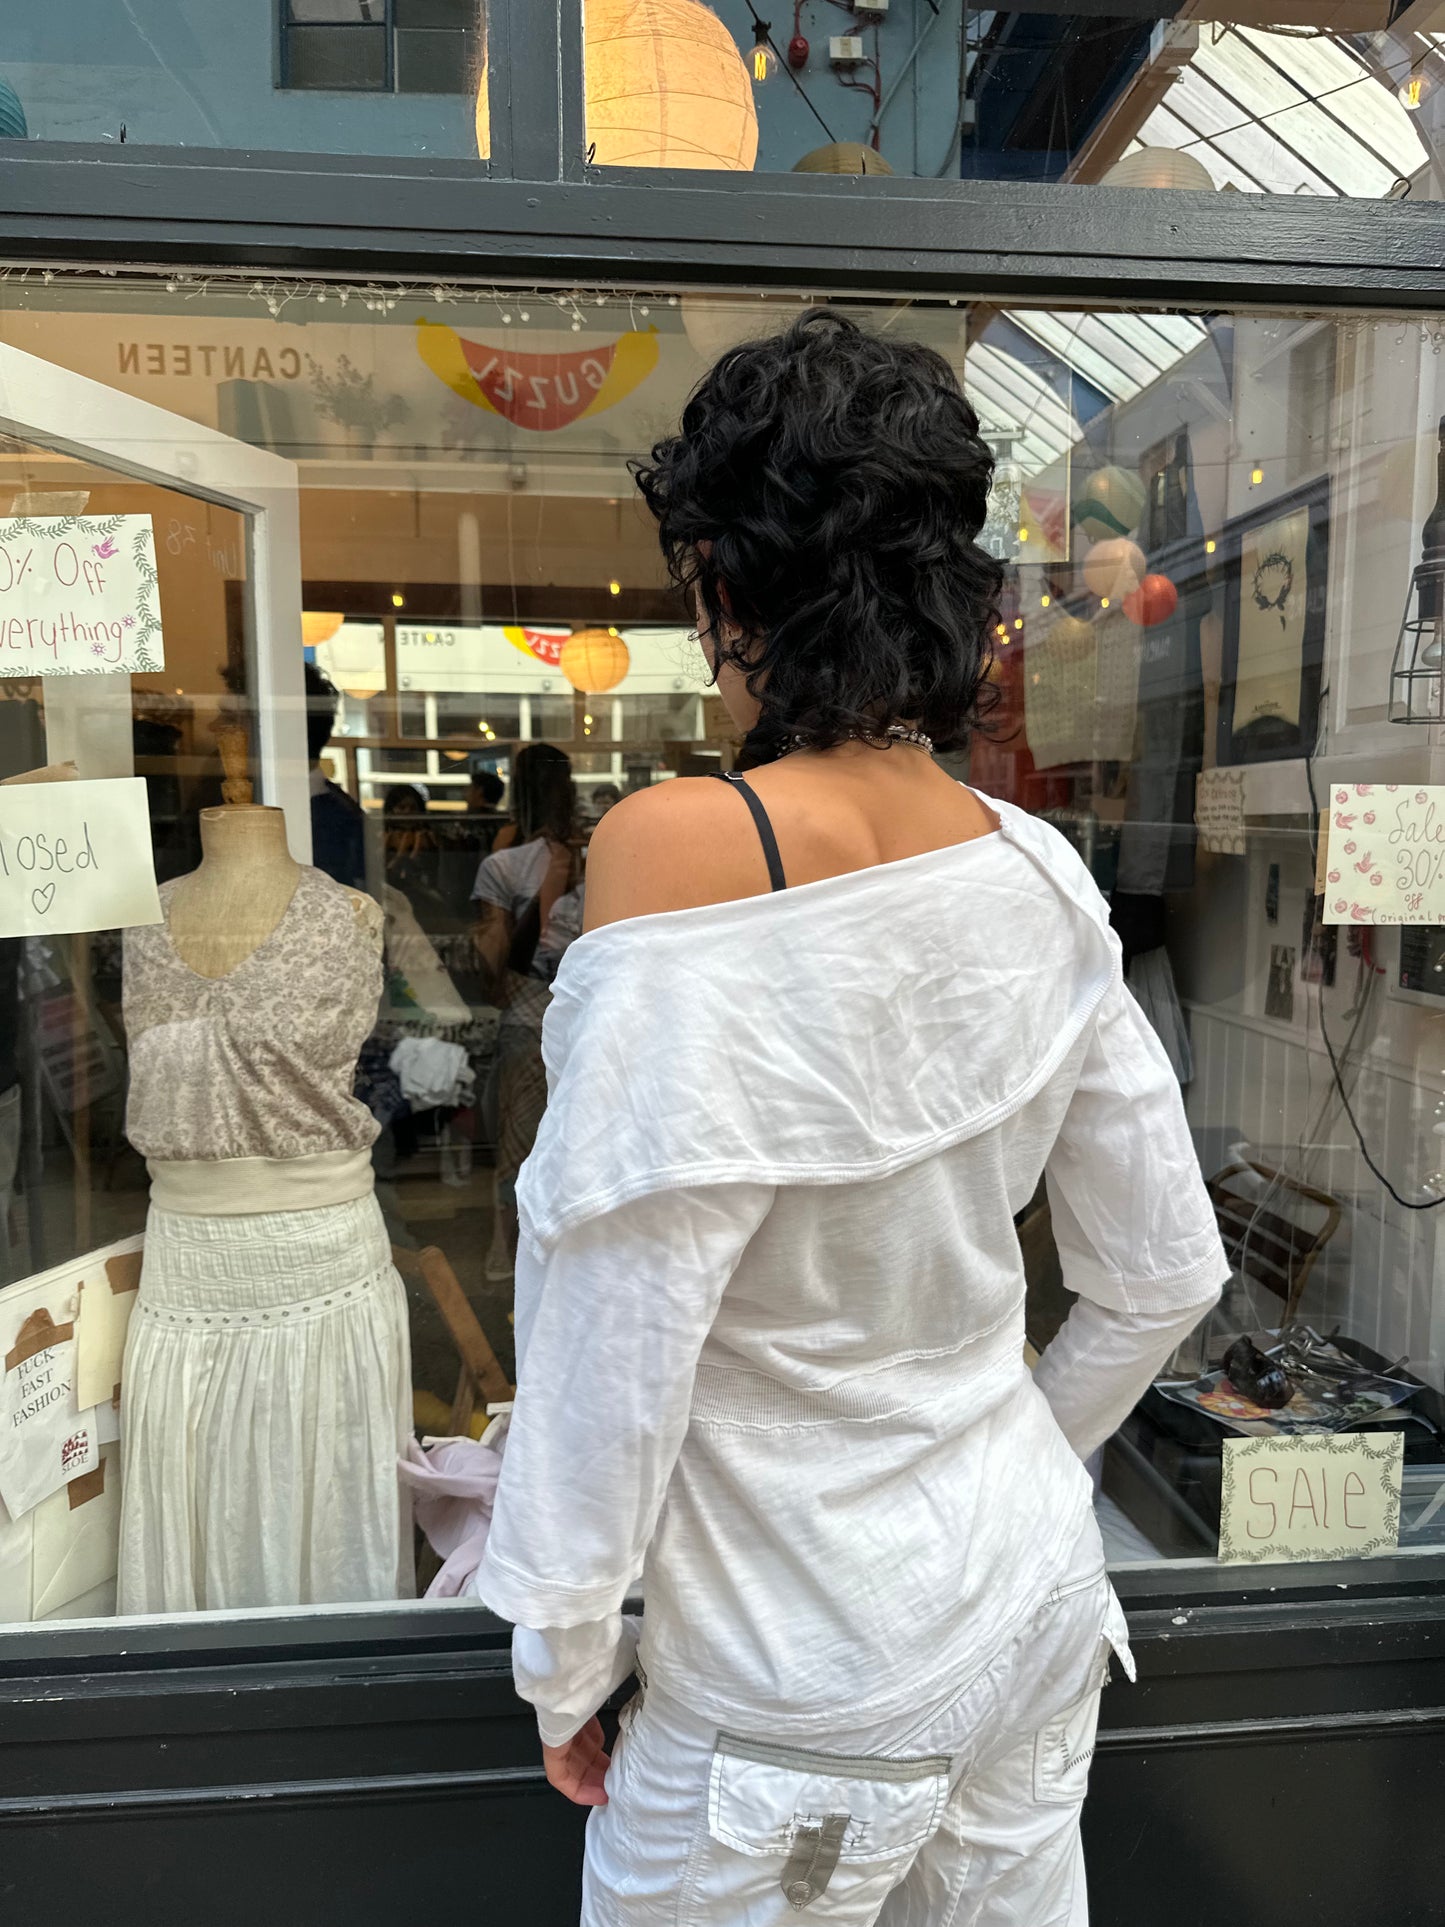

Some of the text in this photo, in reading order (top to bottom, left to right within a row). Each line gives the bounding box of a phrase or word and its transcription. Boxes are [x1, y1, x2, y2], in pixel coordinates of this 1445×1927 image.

[54, 542, 106, 596] Off
[1388, 797, 1445, 845] Sale
[1396, 848, 1445, 891] 30%
[16, 1347, 55, 1380] FUCK
[21, 1368, 54, 1399] FAST
[12, 1379, 72, 1428] FASHION
[62, 1454, 89, 1475] SLOE
